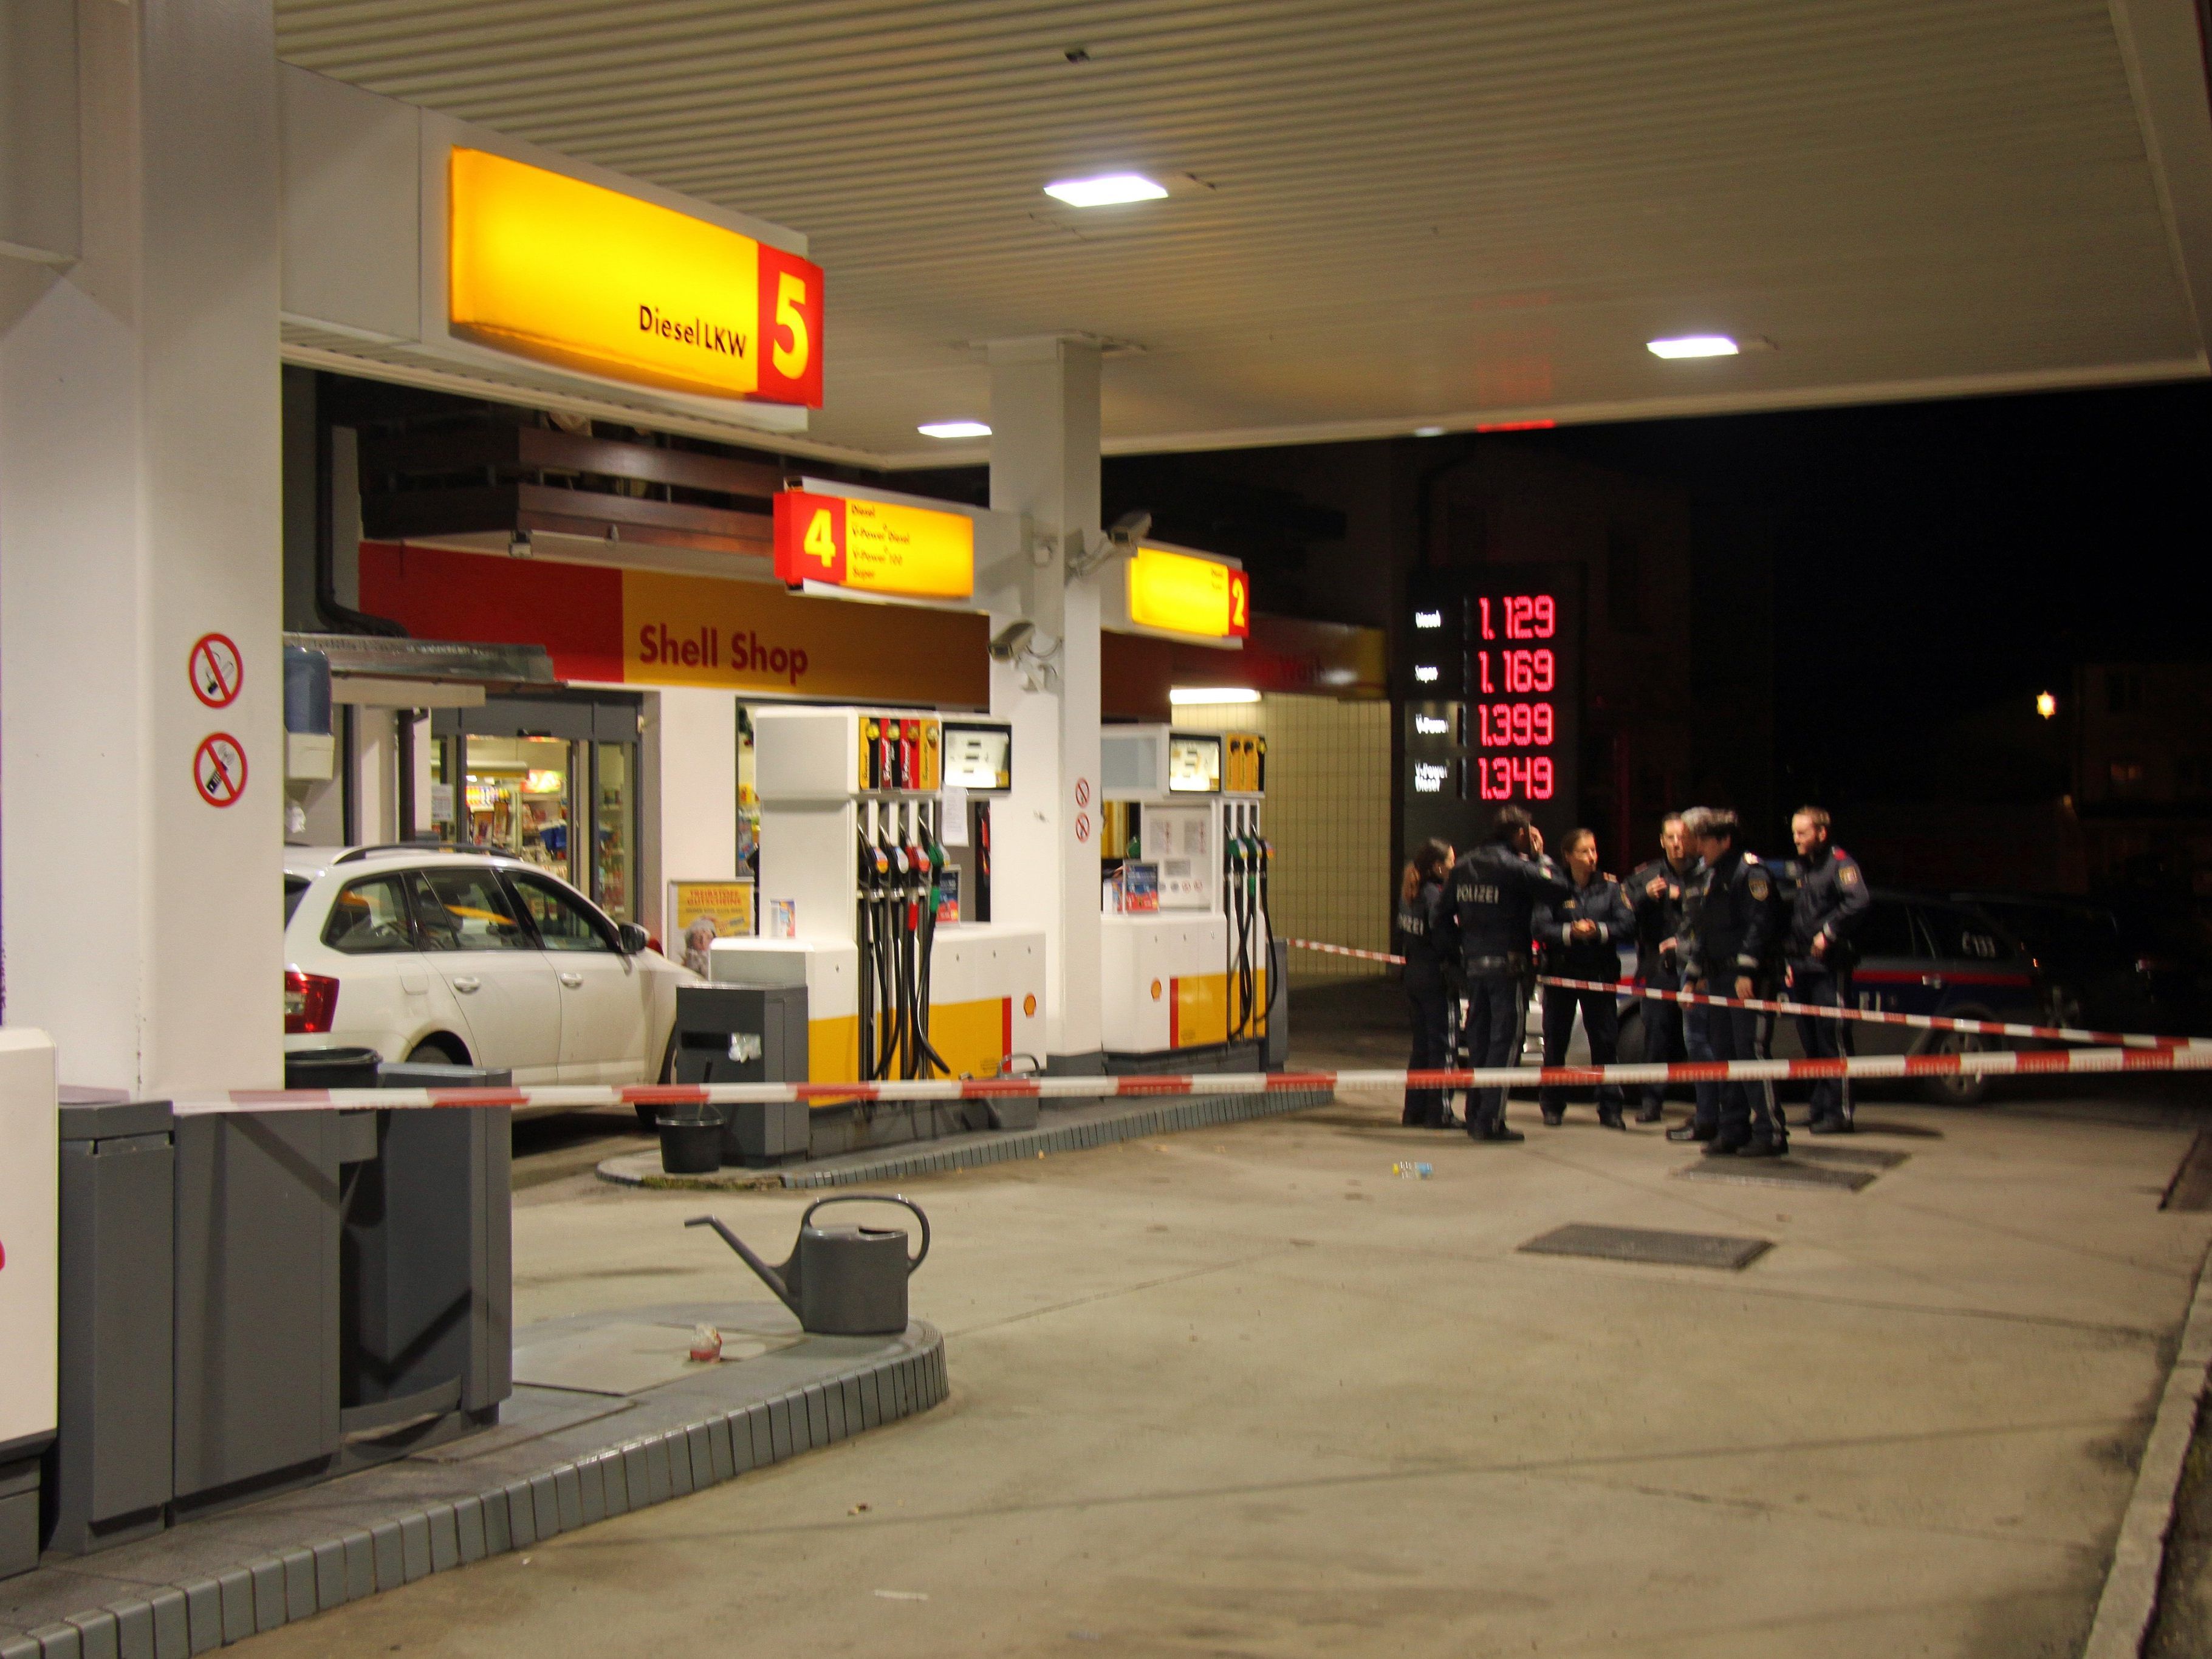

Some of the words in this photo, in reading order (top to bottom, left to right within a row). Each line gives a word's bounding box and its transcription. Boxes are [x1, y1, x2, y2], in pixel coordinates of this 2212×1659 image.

[639, 304, 700, 346] Diesel
[705, 324, 747, 358] LKW
[772, 271, 809, 380] 5
[803, 508, 837, 568] 4
[1232, 578, 1245, 628] 2
[640, 623, 718, 667] Shell
[731, 630, 809, 686] Shop
[1478, 702, 1554, 747] 1.399
[1478, 756, 1554, 801] 1.349
[1456, 883, 1499, 905] POLIZEI
